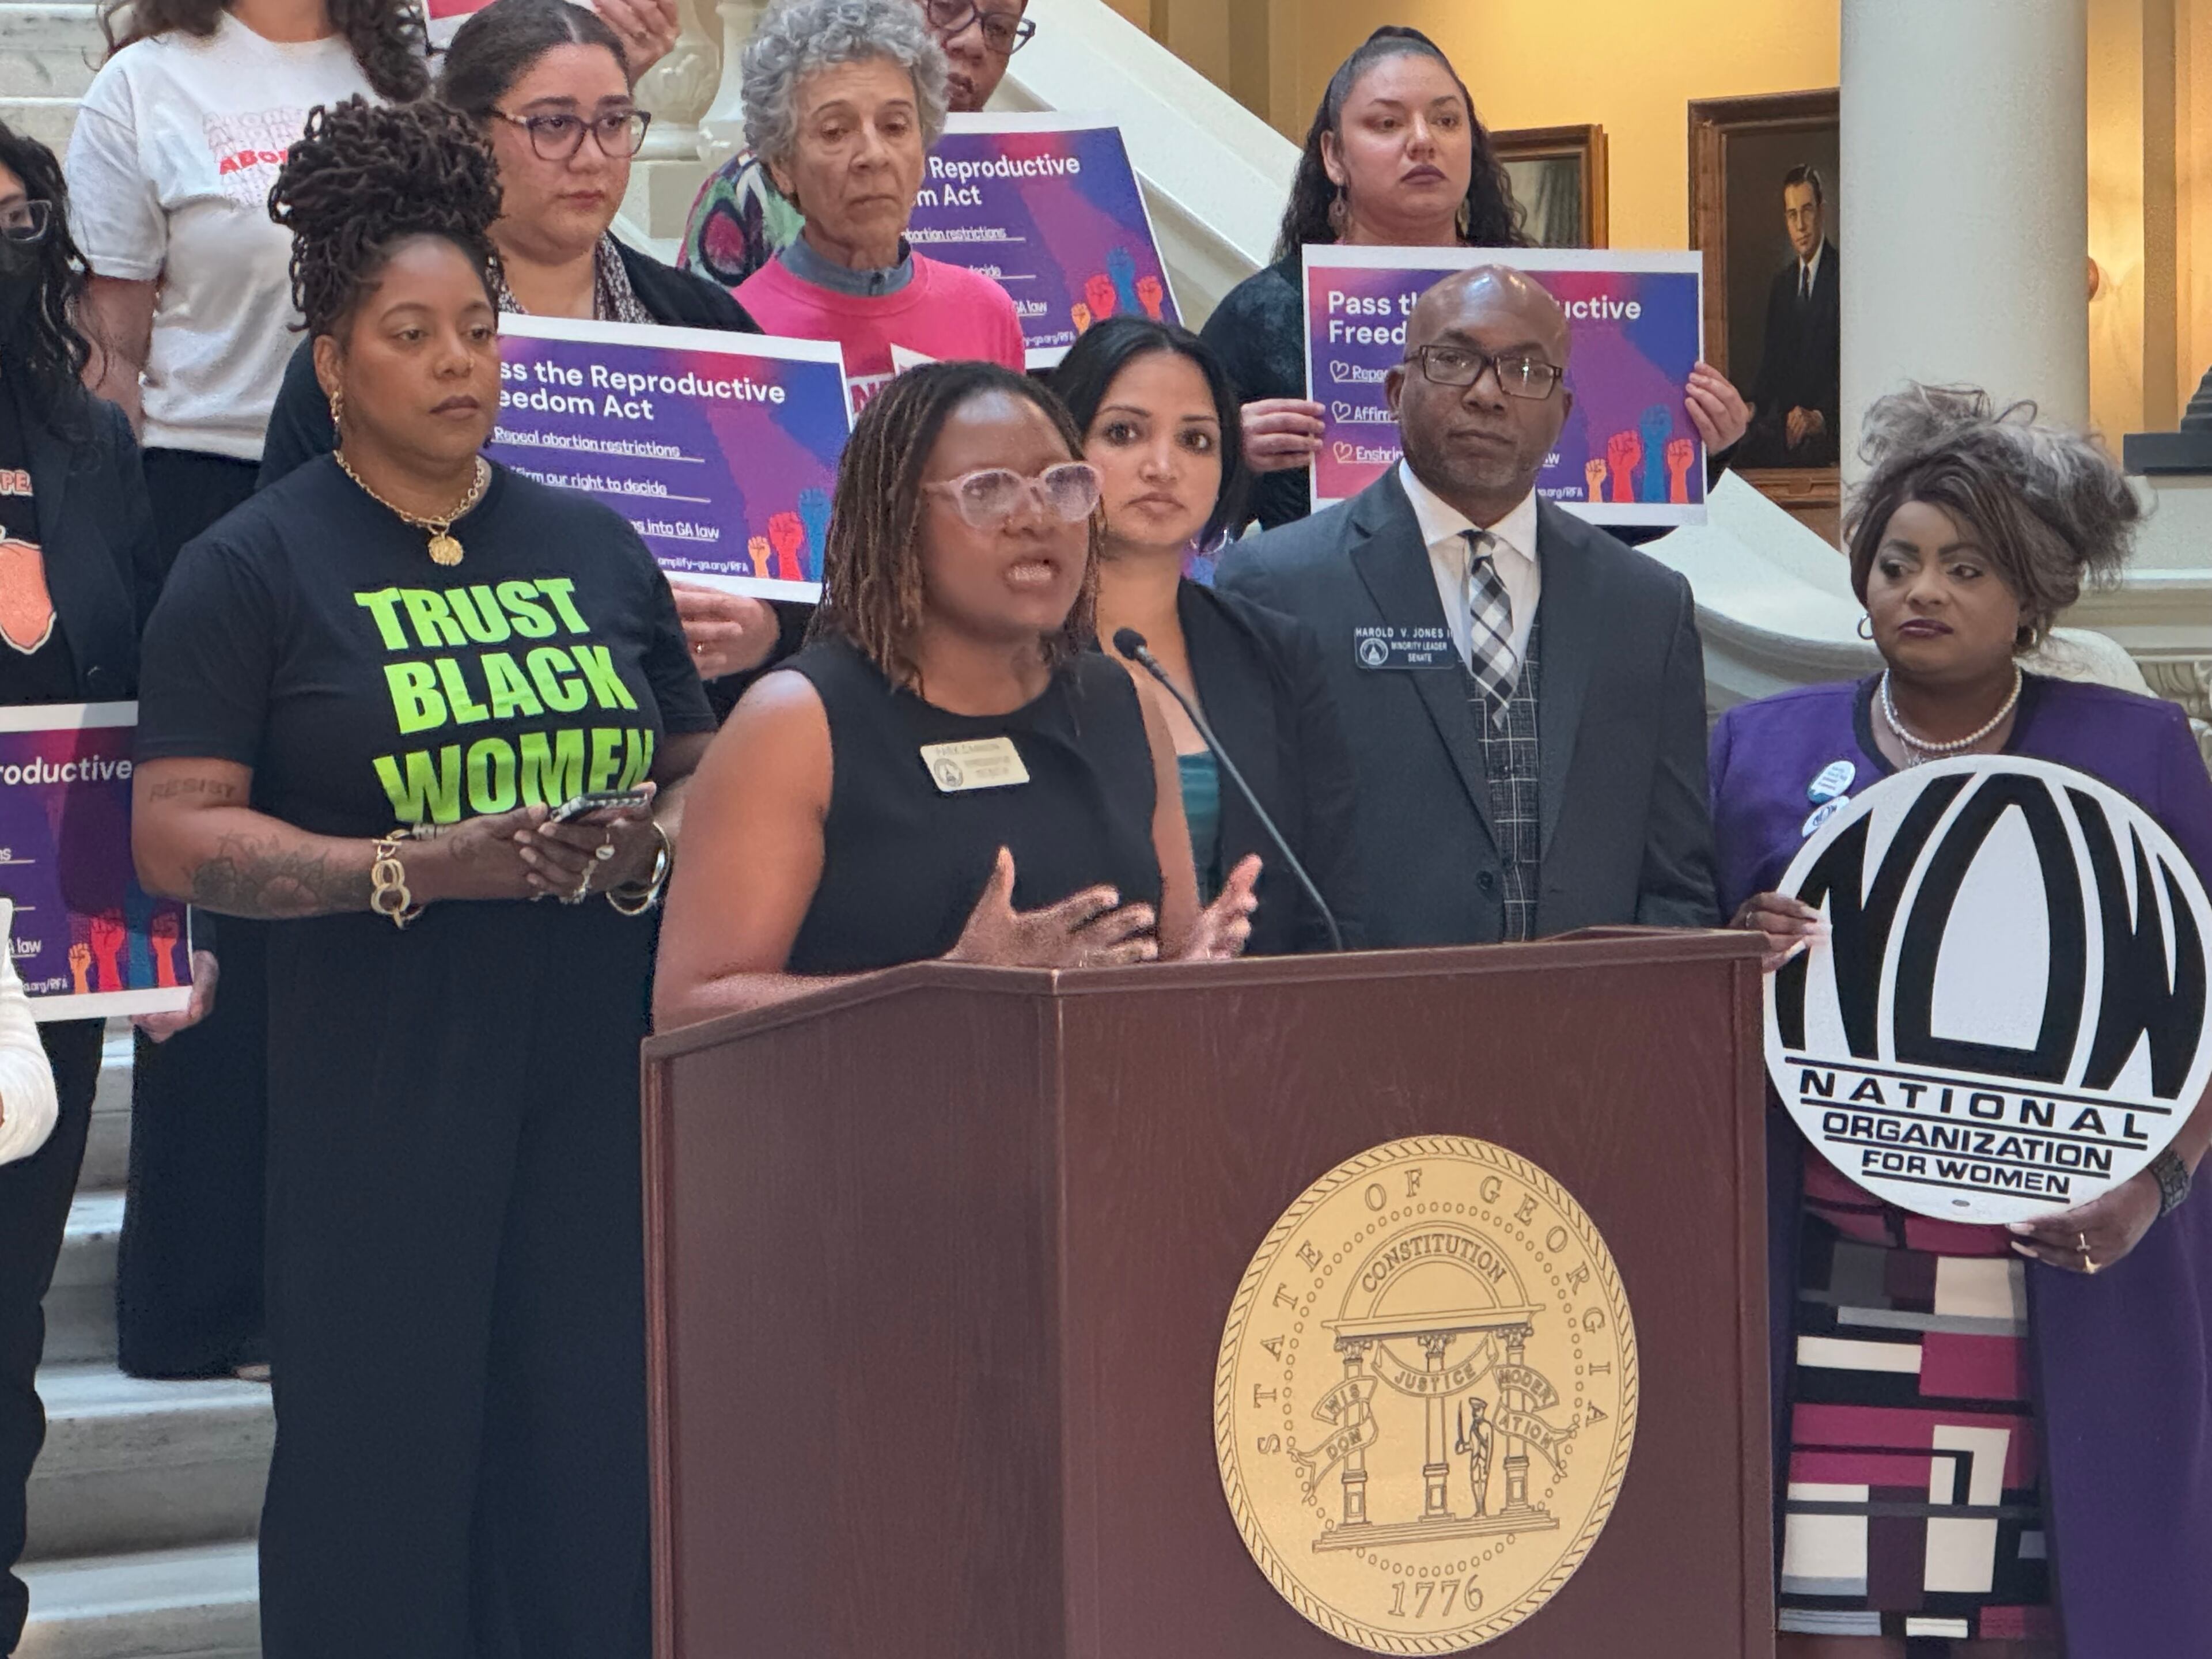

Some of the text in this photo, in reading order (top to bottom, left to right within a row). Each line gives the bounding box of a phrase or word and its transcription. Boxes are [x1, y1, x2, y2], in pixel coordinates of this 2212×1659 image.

[929, 154, 1081, 184] Reproductive
[944, 184, 983, 207] Act
[1328, 290, 1392, 316] Pass
[1328, 319, 1408, 346] Freed
[500, 361, 786, 404] ss the Reproductive
[499, 388, 654, 421] eedom Act
[493, 426, 681, 458] Repeal abortion restrictions
[1355, 445, 1404, 461] Enshrin
[546, 473, 569, 486] our
[571, 472, 604, 491] right
[607, 476, 622, 491] to
[624, 478, 668, 496] decide
[647, 519, 674, 535] into
[676, 521, 694, 536] GA
[696, 522, 719, 539] law
[354, 578, 590, 650] TRUST
[1355, 627, 1394, 638] HAROLD
[1412, 627, 1444, 638] JONES
[1391, 641, 1448, 651] MINORITY LEADER
[1407, 653, 1433, 662] SENATE
[384, 645, 638, 735] BLACK
[372, 728, 654, 825] WOMEN
[16, 936, 42, 953] law
[1775, 771, 2207, 1100] NOW
[1800, 1069, 2149, 1141] NATIONAL
[1822, 1111, 2113, 1172] ORGANIZATION
[1861, 1149, 2071, 1195] FOR WOMEN
[1361, 1232, 1508, 1294] CONSTITUTION
[1253, 1168, 1612, 1456] STATE OF GEORGIA
[1394, 1363, 1476, 1393] JUSTICE
[1324, 1383, 1361, 1414] WIS
[1498, 1415, 1556, 1451] ATION
[1387, 1572, 1484, 1619] 1776
